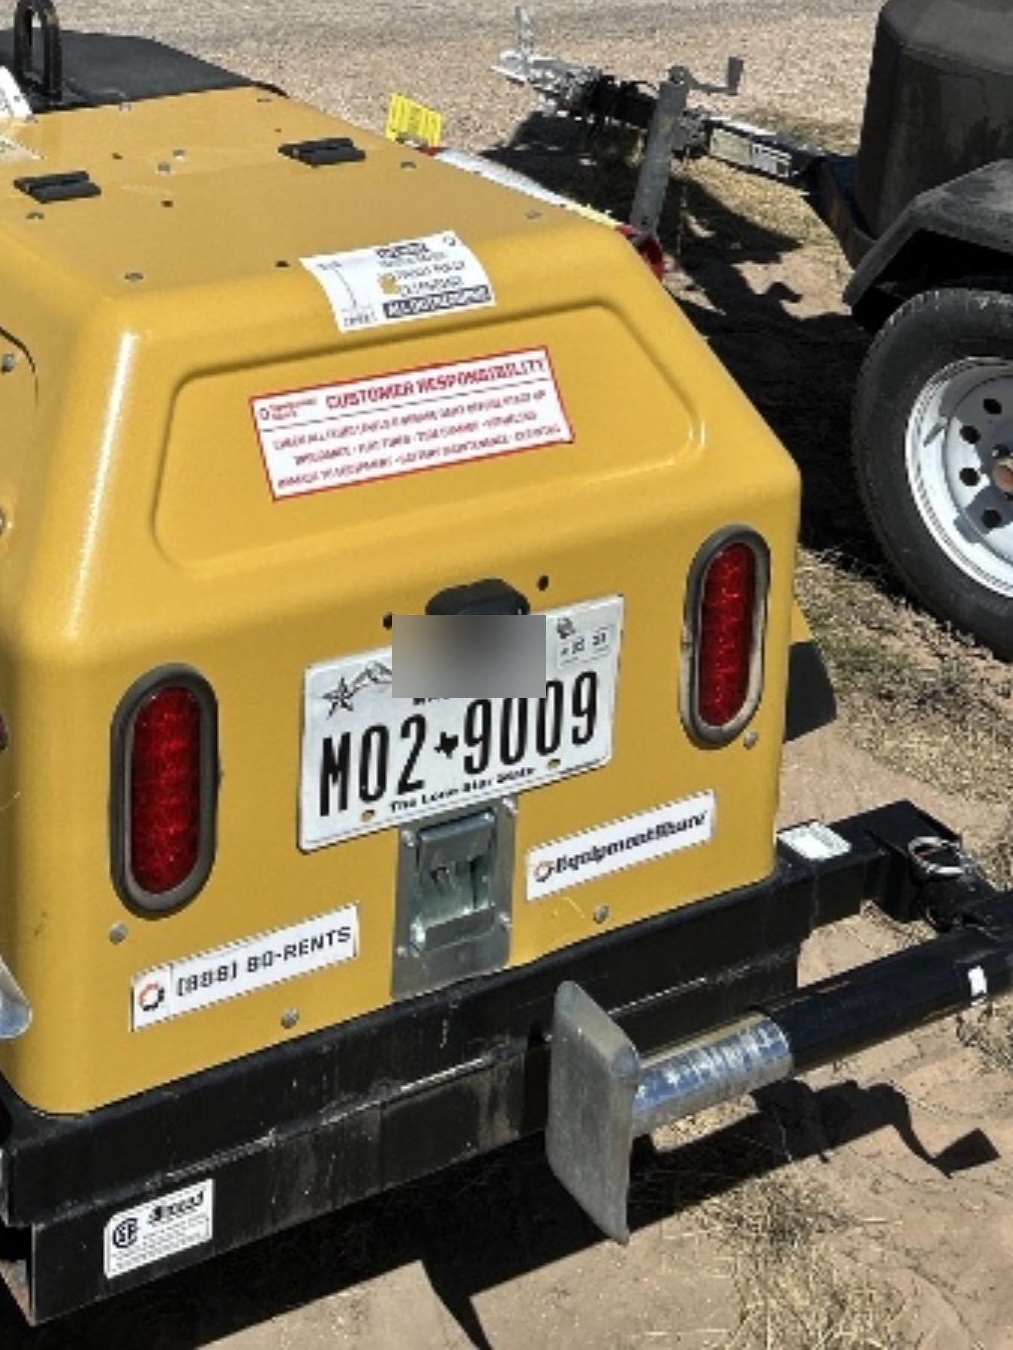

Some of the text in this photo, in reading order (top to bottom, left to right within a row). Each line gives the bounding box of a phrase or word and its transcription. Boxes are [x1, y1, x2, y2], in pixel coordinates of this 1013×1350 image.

[325, 380, 414, 410] CUSTOMER
[463, 670, 599, 776] 9009
[390, 799, 417, 812] The
